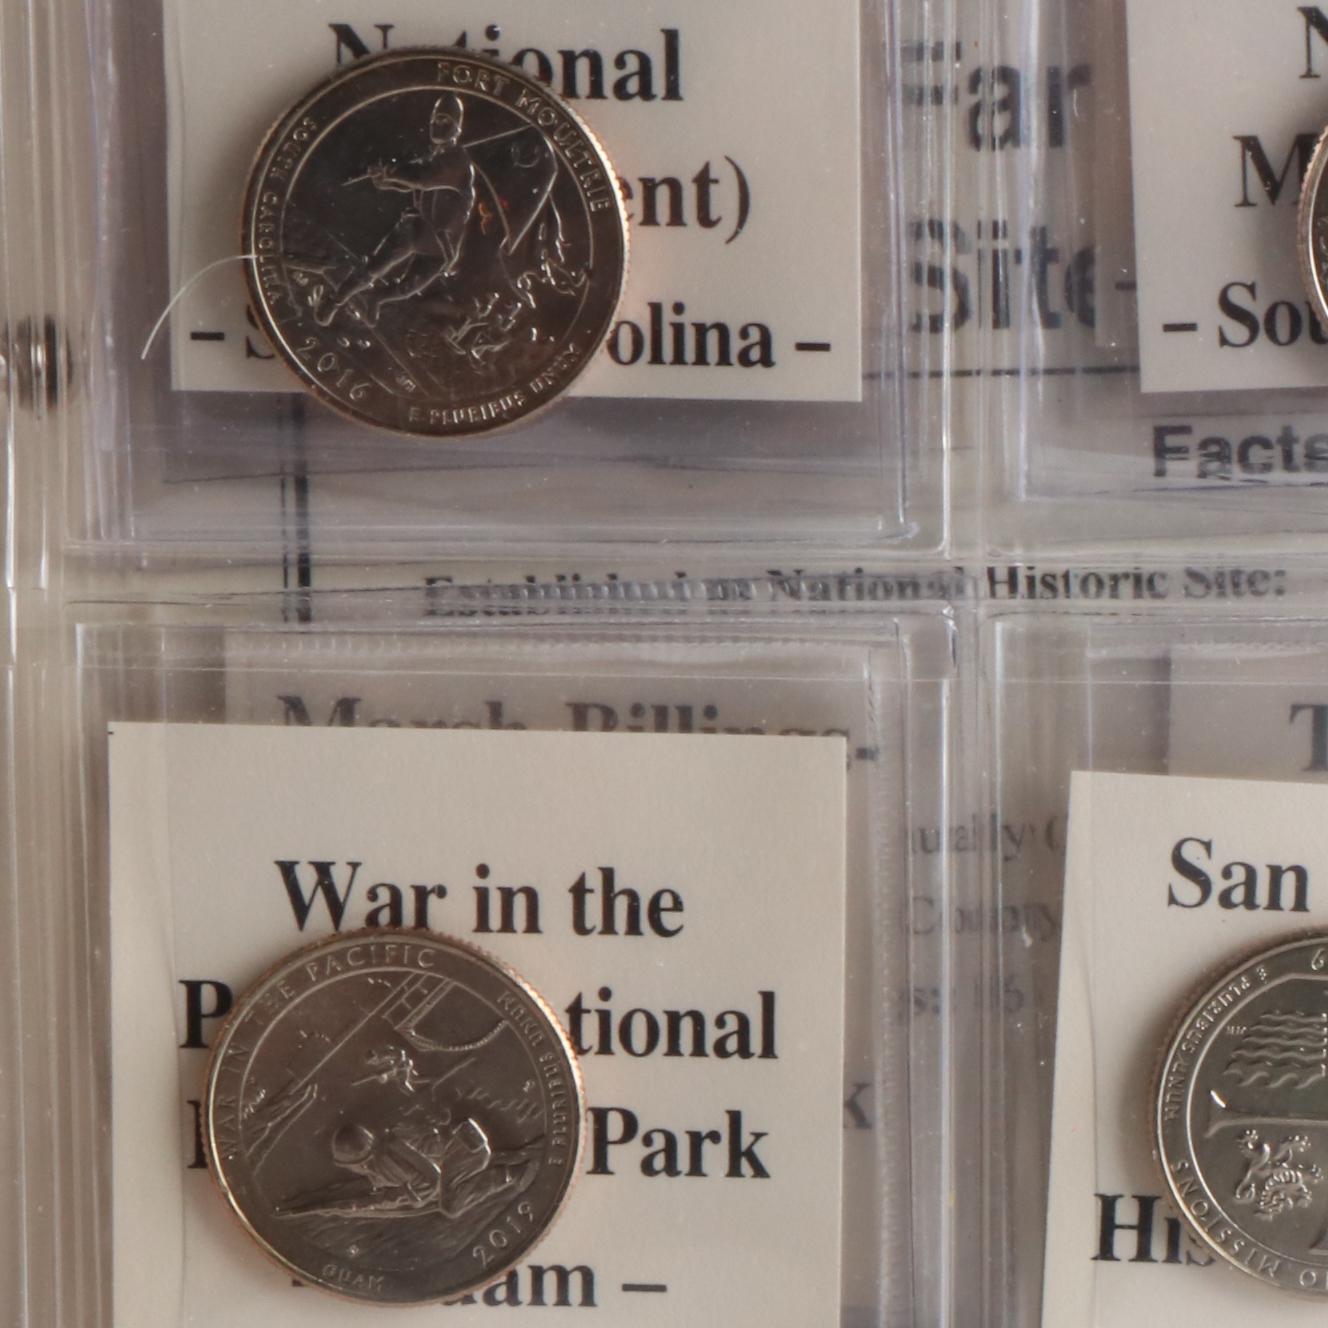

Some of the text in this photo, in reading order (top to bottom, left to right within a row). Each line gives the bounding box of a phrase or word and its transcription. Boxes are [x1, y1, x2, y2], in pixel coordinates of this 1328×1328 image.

[436, 62, 509, 92] FORT
[515, 88, 611, 213] MOULTRIE
[298, 336, 372, 401] 2016
[987, 566, 1168, 601] Historic
[273, 860, 685, 938] War in the
[1166, 837, 1310, 913] San
[306, 944, 436, 983] PACIFIC
[565, 989, 779, 1060] tional
[586, 1107, 772, 1181] Park
[472, 1201, 535, 1269] 2019
[1174, 1159, 1282, 1278] MISSIONS
